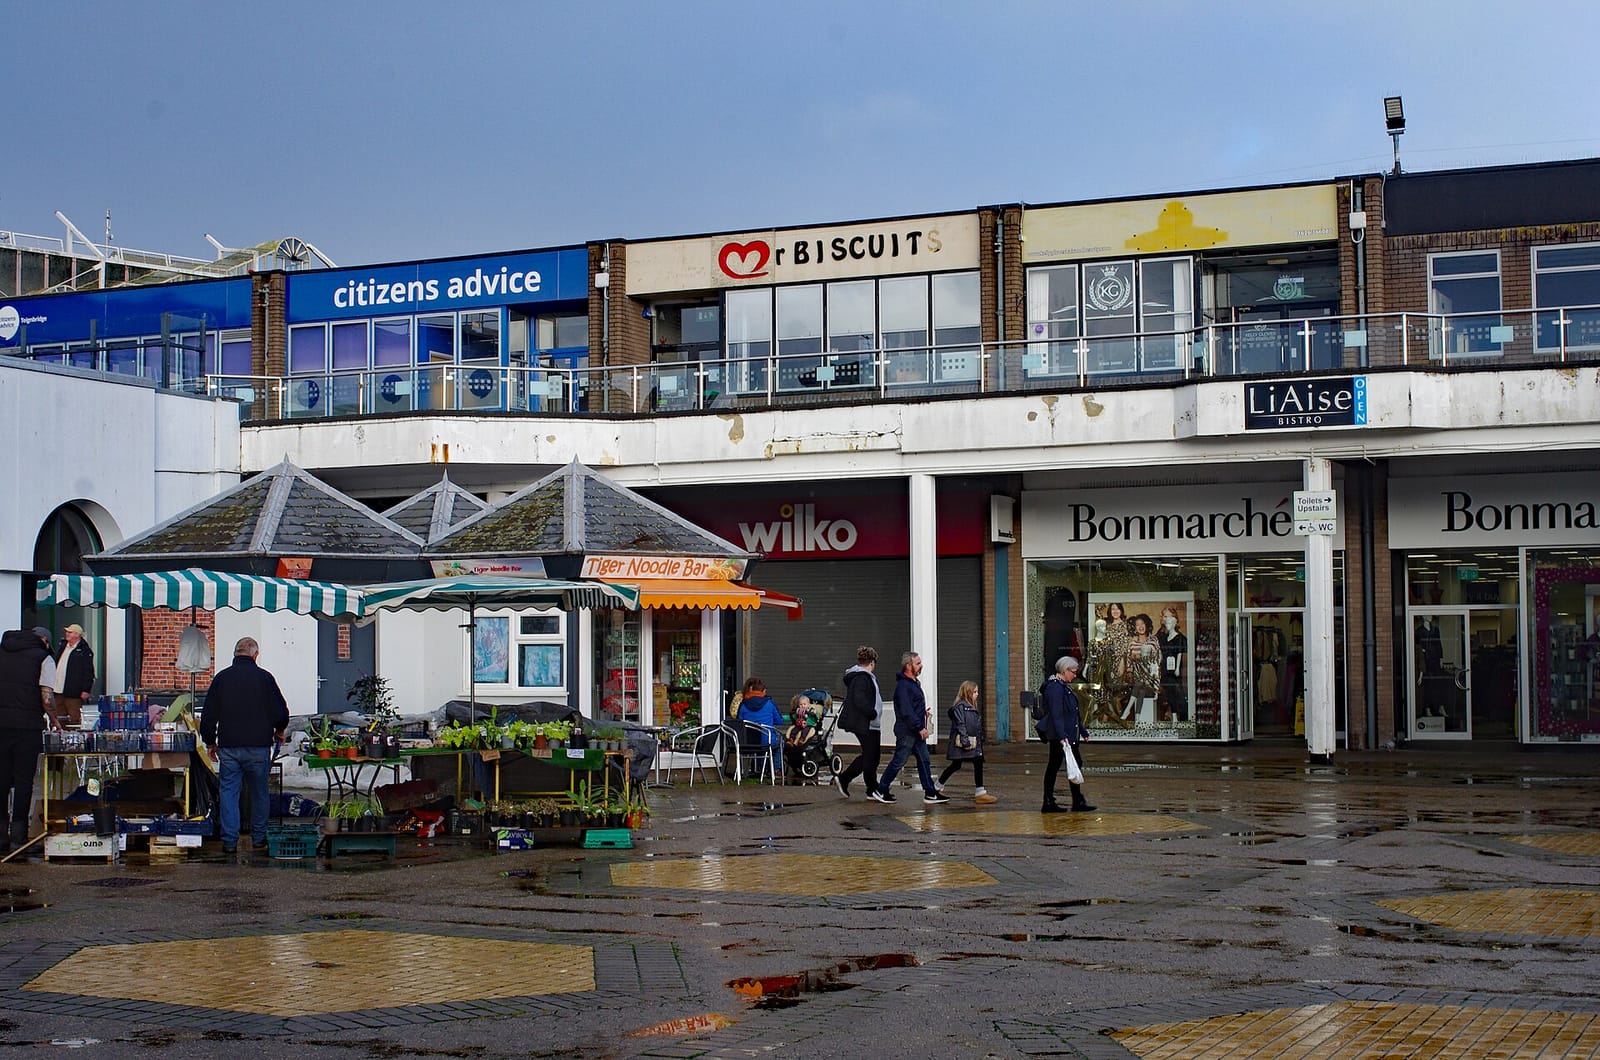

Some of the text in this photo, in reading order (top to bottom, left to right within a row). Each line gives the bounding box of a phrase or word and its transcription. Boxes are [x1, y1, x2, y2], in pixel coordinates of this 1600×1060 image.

[794, 229, 943, 265] BISCUITS
[333, 266, 541, 308] citizens advice
[1249, 383, 1352, 414] LiAise
[1355, 378, 1366, 423] OPEN
[1278, 415, 1322, 425] BISTRO
[1297, 497, 1323, 505] Toilets
[1297, 505, 1330, 513] Upstairs
[738, 503, 858, 552] wilko
[1068, 497, 1292, 542] Bonmarché
[1318, 523, 1334, 531] WC
[474, 566, 489, 574] Tiger
[490, 565, 510, 573] Noodle
[586, 557, 709, 577] Tiger Noodle Bar
